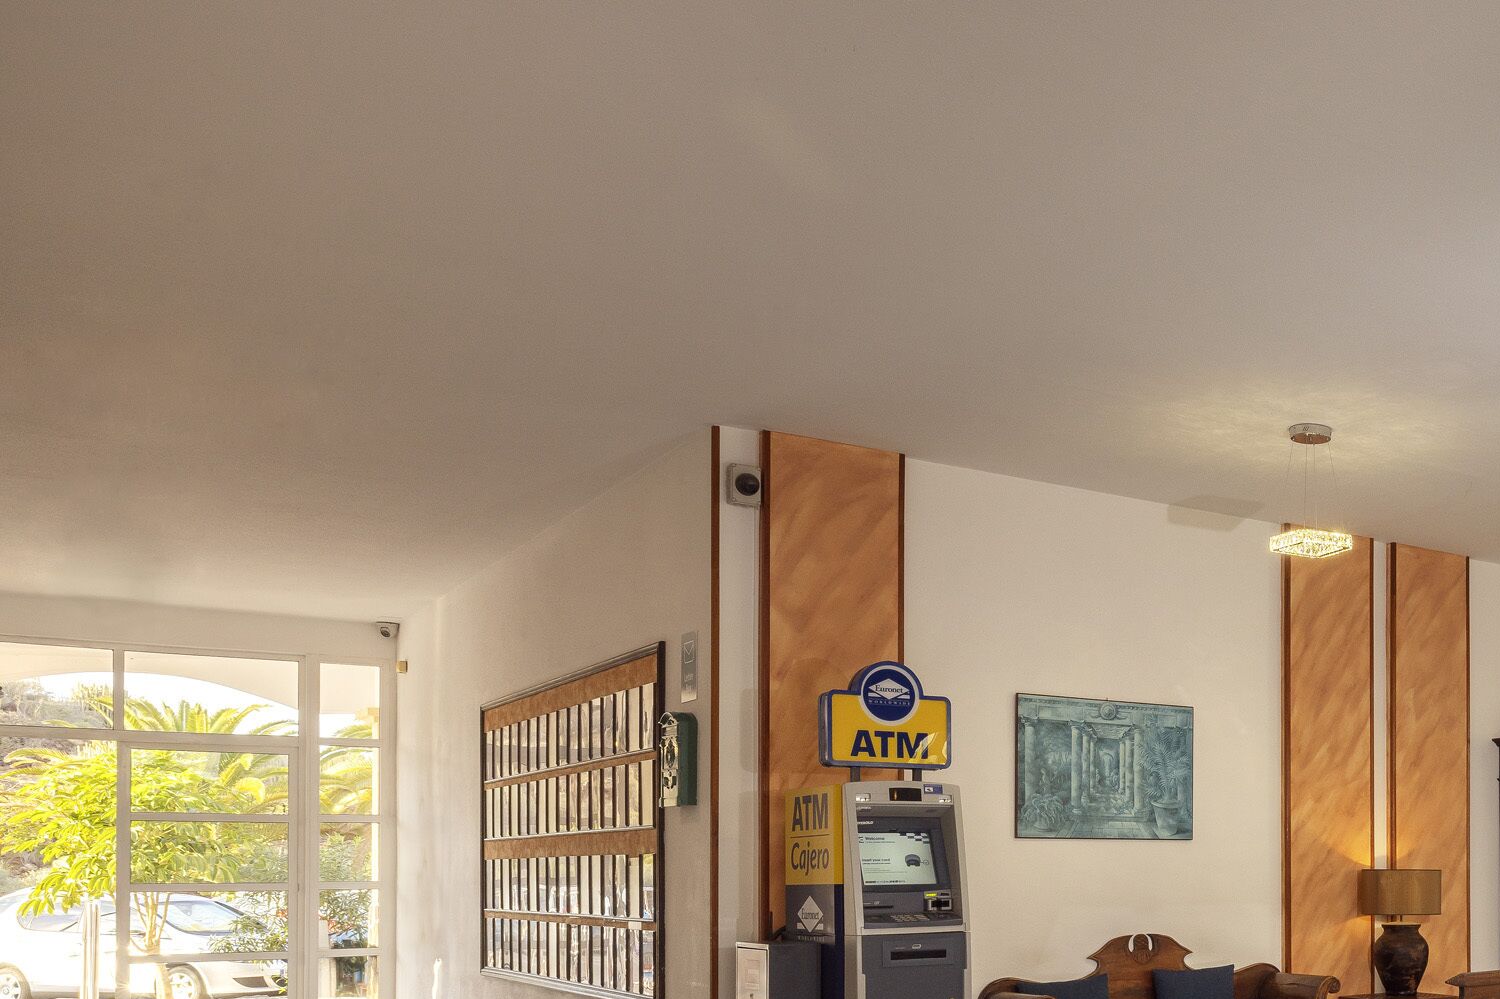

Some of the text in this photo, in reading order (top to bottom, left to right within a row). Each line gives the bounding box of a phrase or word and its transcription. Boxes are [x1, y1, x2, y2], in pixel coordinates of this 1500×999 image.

[875, 685, 903, 693] Euronet
[851, 729, 929, 760] ATM
[791, 793, 829, 832] ATM
[791, 841, 830, 876] Cajero
